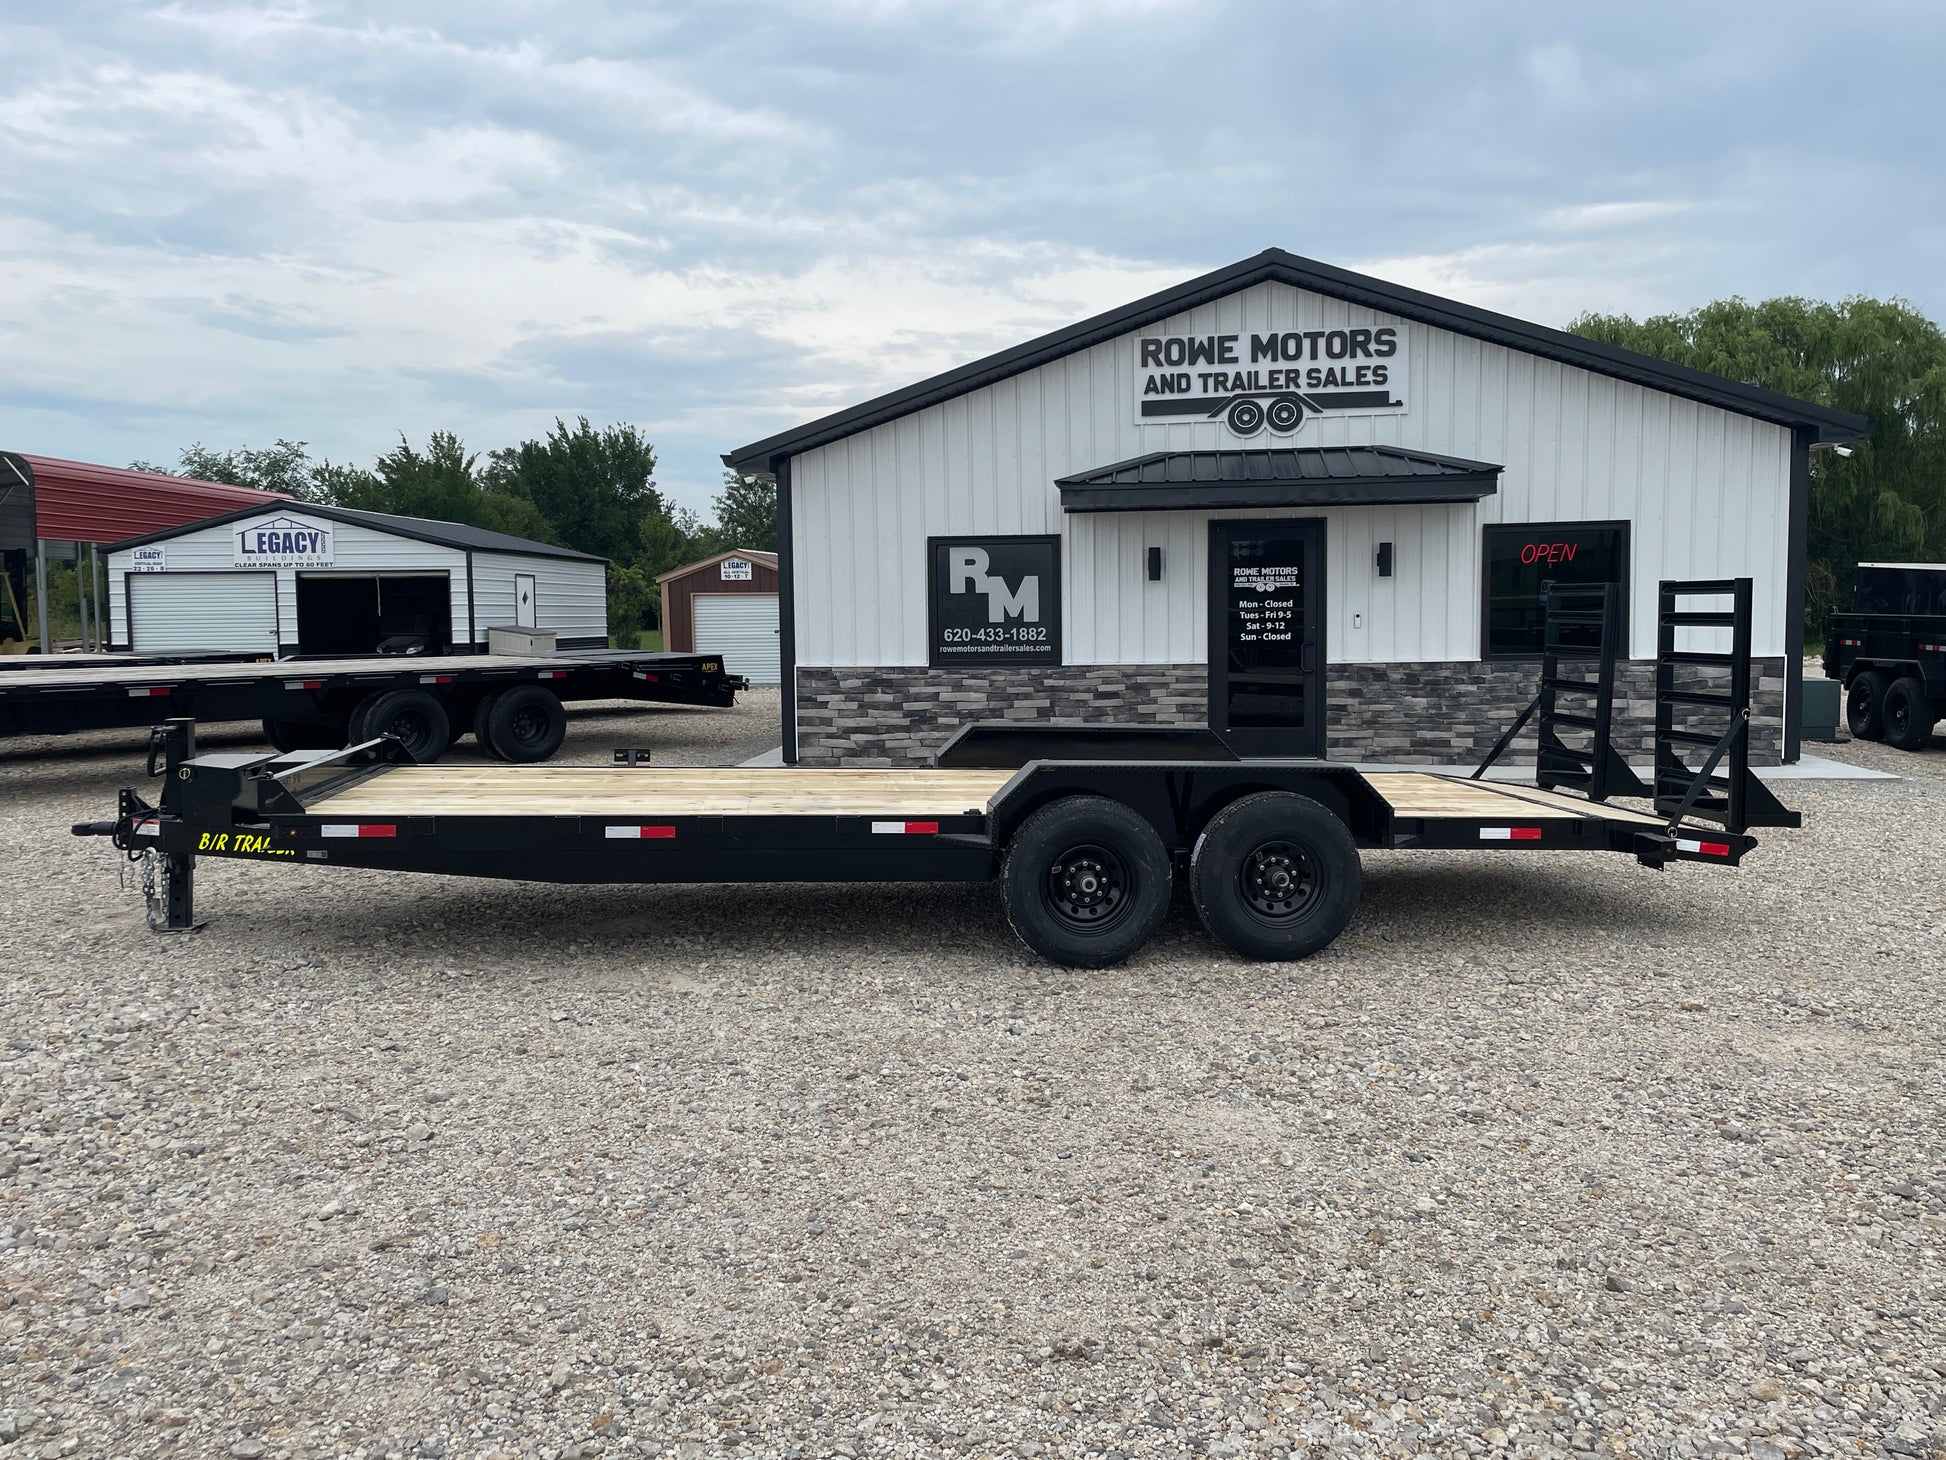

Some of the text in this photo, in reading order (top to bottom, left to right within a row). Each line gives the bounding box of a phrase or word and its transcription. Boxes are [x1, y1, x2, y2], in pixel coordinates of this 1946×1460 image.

[1141, 328, 1397, 368] ROWE MOTORS
[1144, 365, 1388, 394] AND TRAILER SALES
[241, 531, 319, 554] LEGACY
[133, 551, 161, 560] LEGACY
[1521, 544, 1578, 564] OPEN
[722, 561, 748, 569] LEGACY
[1234, 567, 1298, 576] ROWE MOTORS
[949, 547, 1040, 623] RM
[1239, 600, 1258, 608] Mon
[1264, 600, 1293, 608] Closed
[1240, 611, 1260, 619] Tues
[1265, 611, 1277, 619] Fri
[1246, 622, 1260, 630] Sat
[944, 628, 1047, 642] 620-433-1882
[1240, 633, 1257, 641] Sun
[1263, 632, 1291, 640] Closed
[939, 644, 1051, 653] rowemotorsandtrailersales.com
[701, 662, 718, 671] APEX
[198, 832, 295, 856] B/R TRAI
